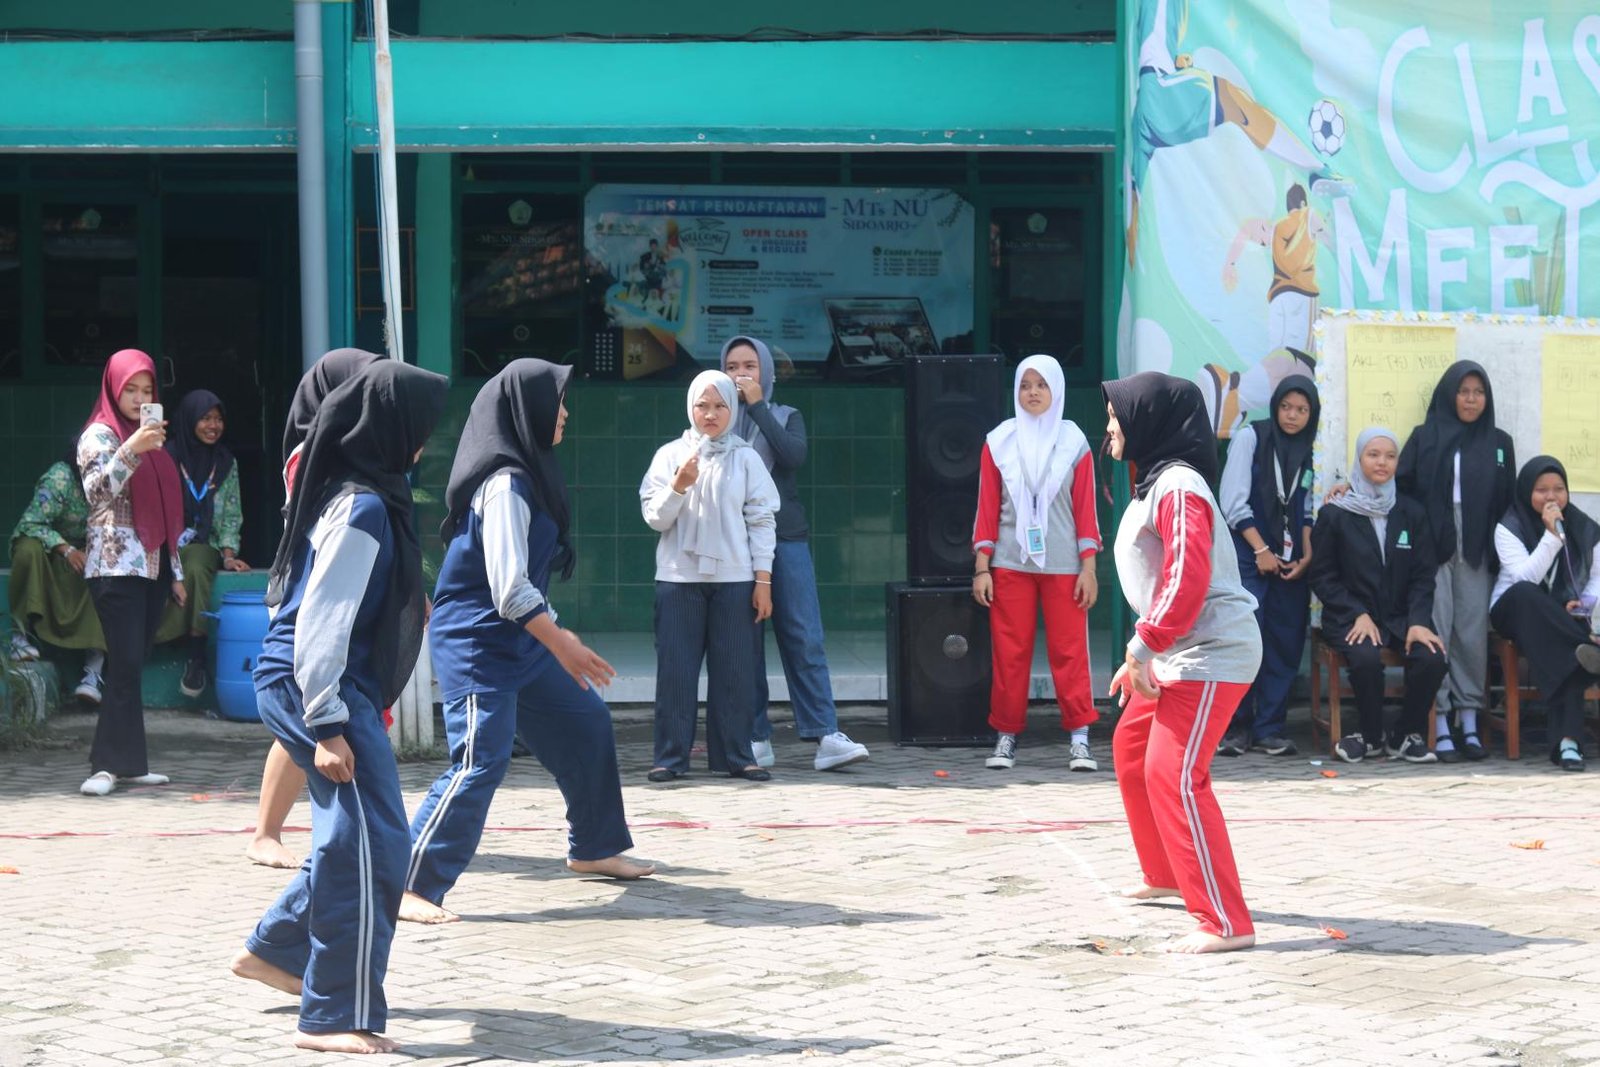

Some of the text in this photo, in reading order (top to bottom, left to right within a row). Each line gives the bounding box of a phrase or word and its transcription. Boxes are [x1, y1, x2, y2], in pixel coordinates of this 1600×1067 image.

[704, 200, 818, 214] PENDAFTARAN
[892, 198, 929, 217] NU
[742, 229, 808, 238] OPEN CLASS
[627, 354, 642, 365] 25
